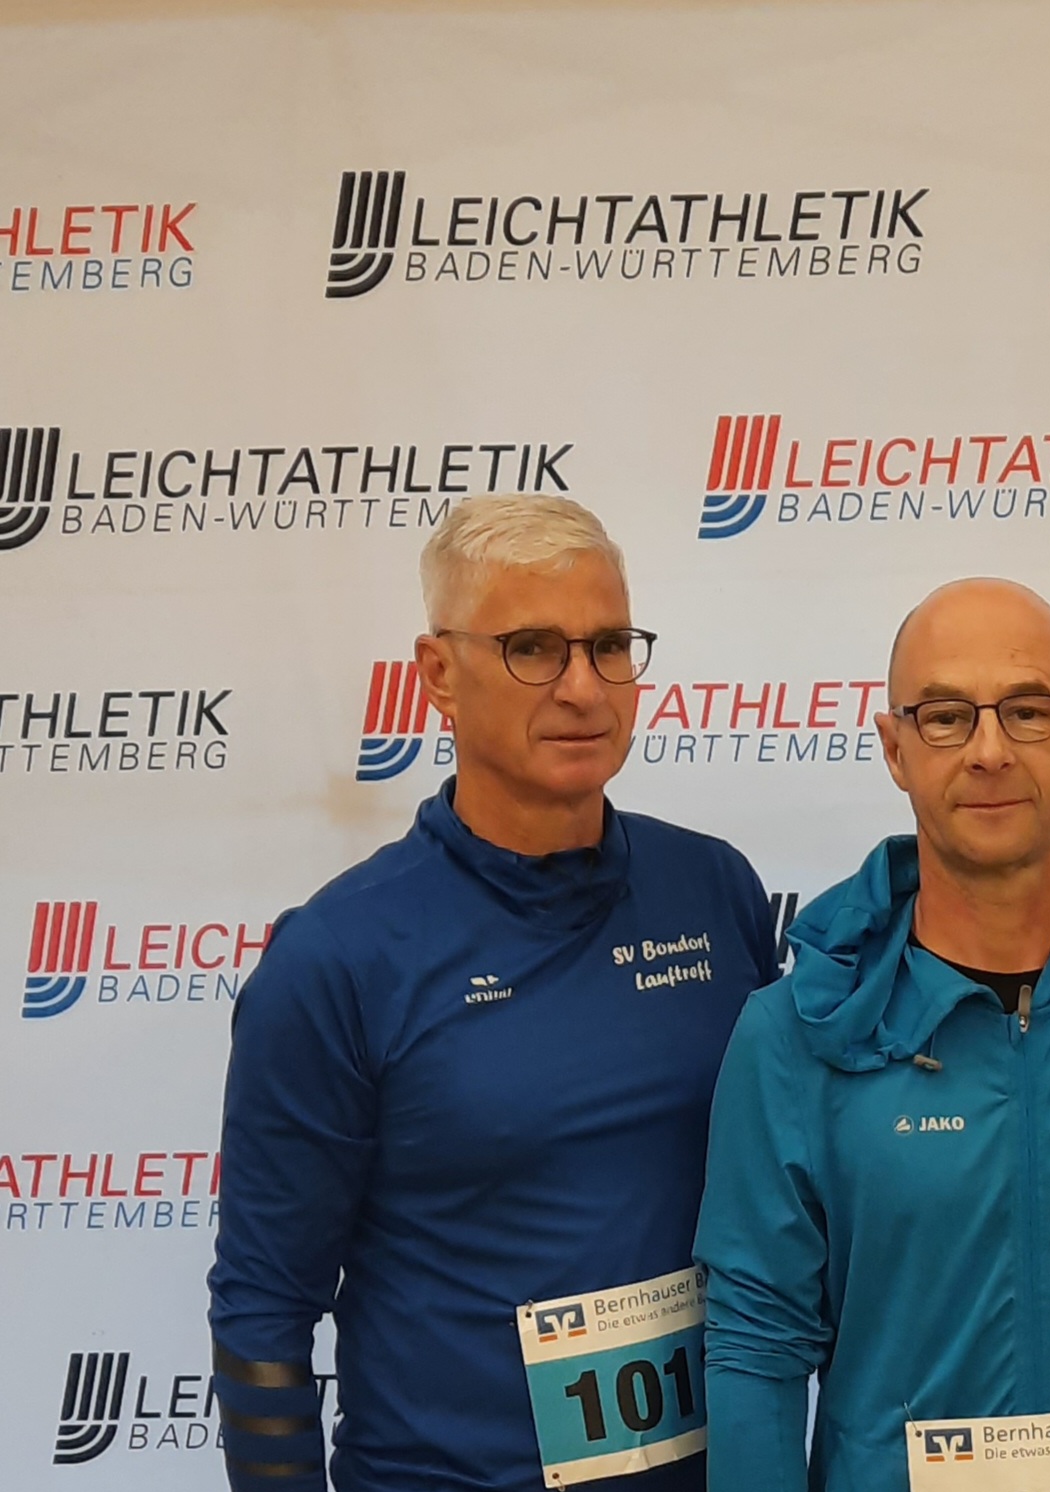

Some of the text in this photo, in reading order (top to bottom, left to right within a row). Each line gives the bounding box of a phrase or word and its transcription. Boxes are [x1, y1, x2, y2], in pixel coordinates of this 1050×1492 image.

[411, 187, 931, 247] LEICHTATHLETIK
[0, 256, 194, 292] EMBERG
[405, 243, 923, 282] BADEN-WÜRTTEMBERG
[66, 443, 576, 501] LEICHTATHLETIK
[61, 497, 470, 535] BADEN-WÜRTTEM
[612, 931, 712, 966] SV Bondorf
[634, 958, 713, 991] Lauftreff
[918, 1116, 965, 1132] JAKO
[593, 1277, 692, 1317] Bernhauser
[597, 1319, 620, 1332] Die
[564, 1346, 695, 1442] 101
[984, 1447, 1008, 1460] Die
